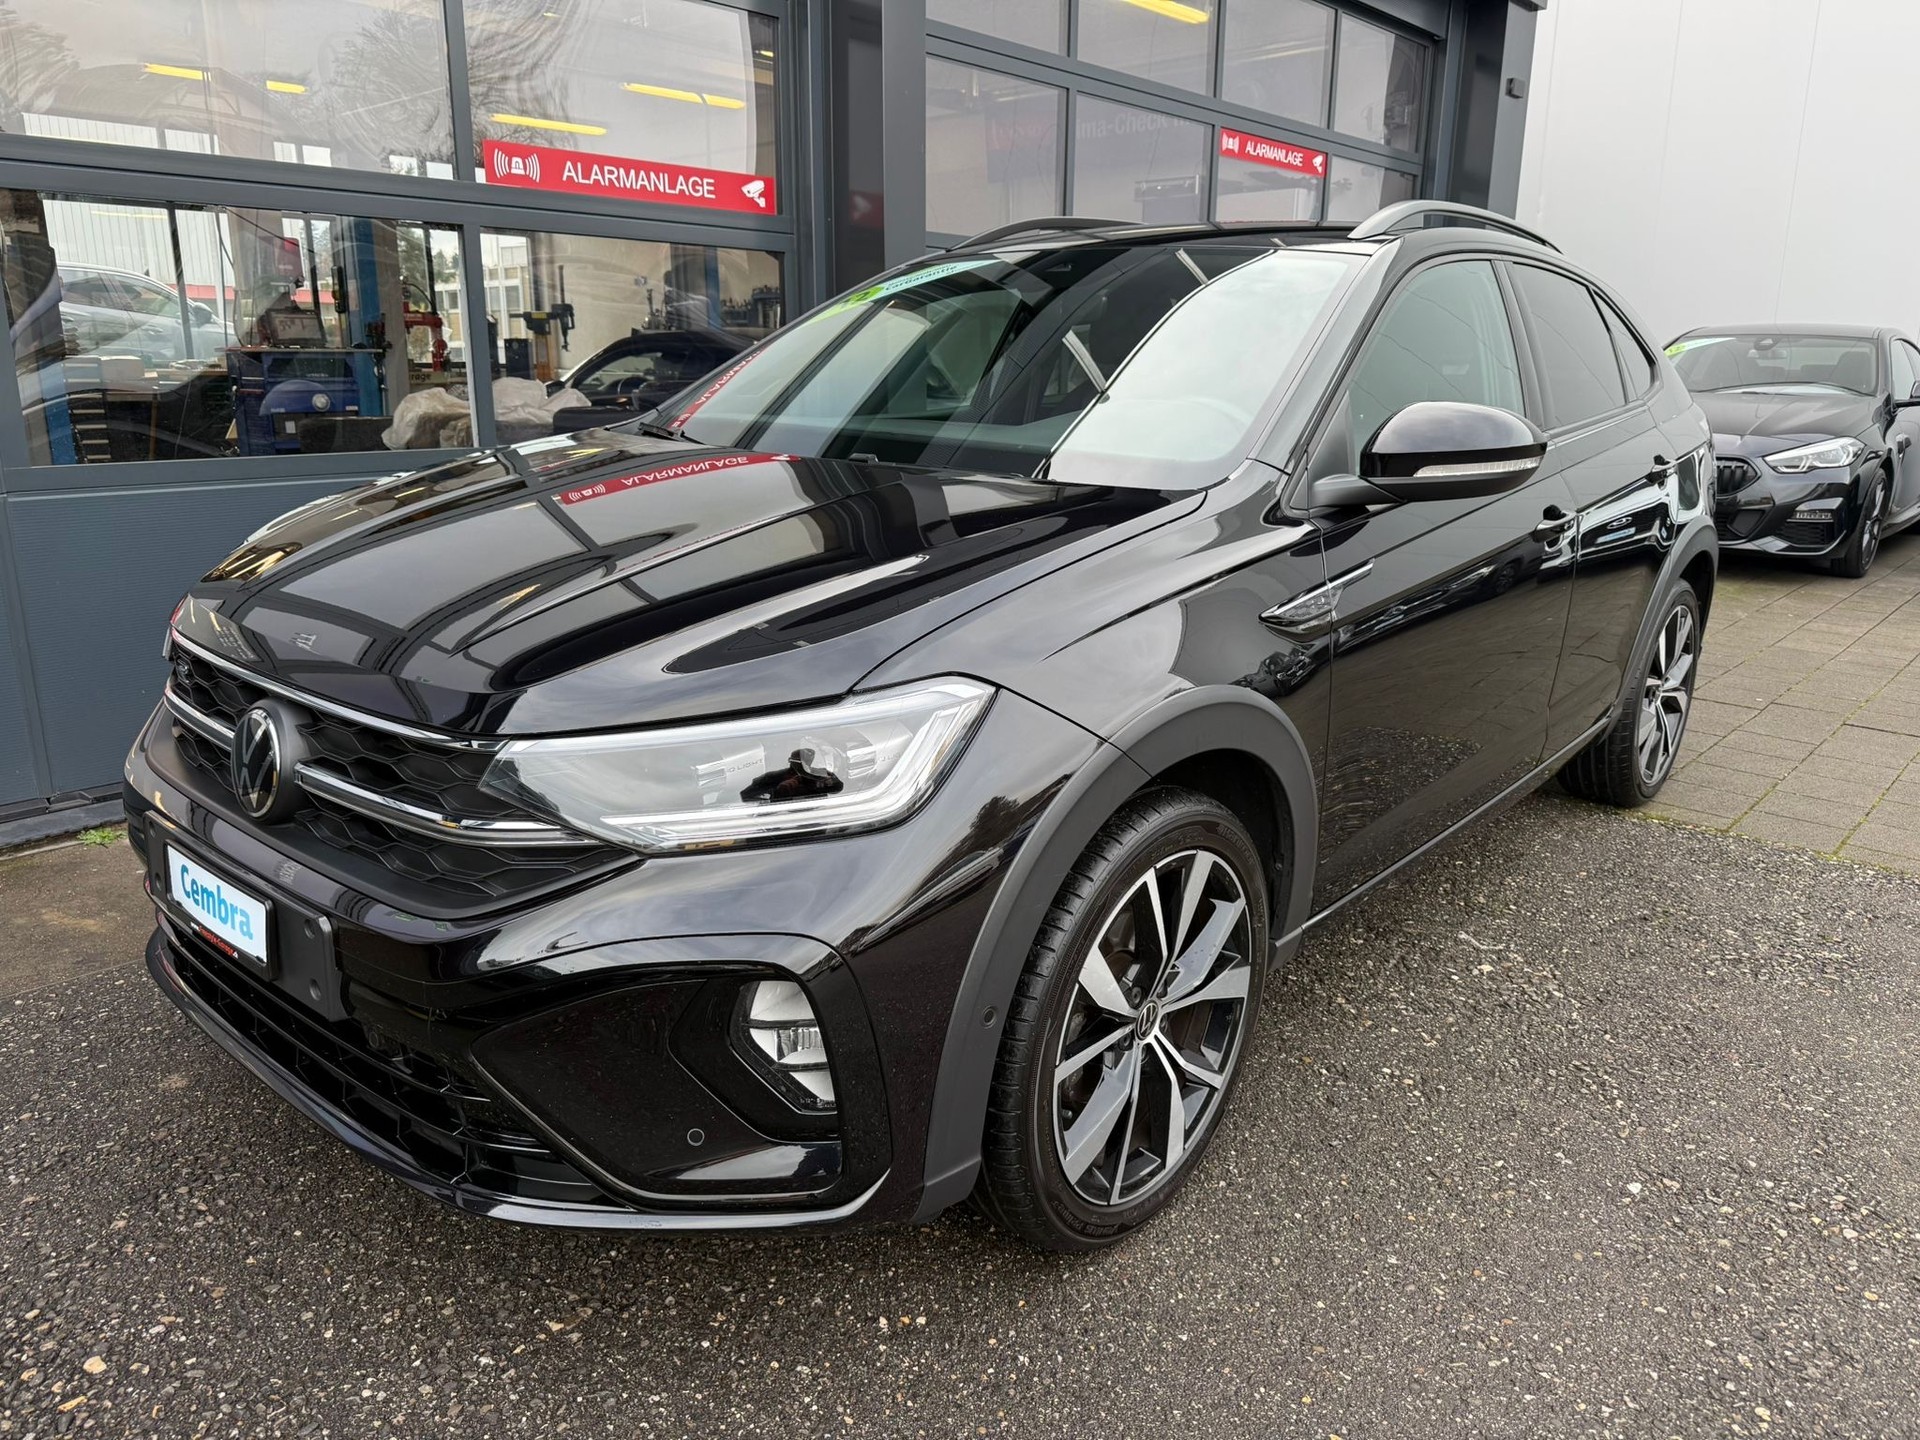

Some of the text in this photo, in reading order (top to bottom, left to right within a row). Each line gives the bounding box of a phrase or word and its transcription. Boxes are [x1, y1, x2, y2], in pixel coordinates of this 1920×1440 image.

[1245, 140, 1303, 167] ALARMANLAGE
[562, 160, 716, 199] ALARMANLAGE
[180, 864, 254, 941] Cembra
